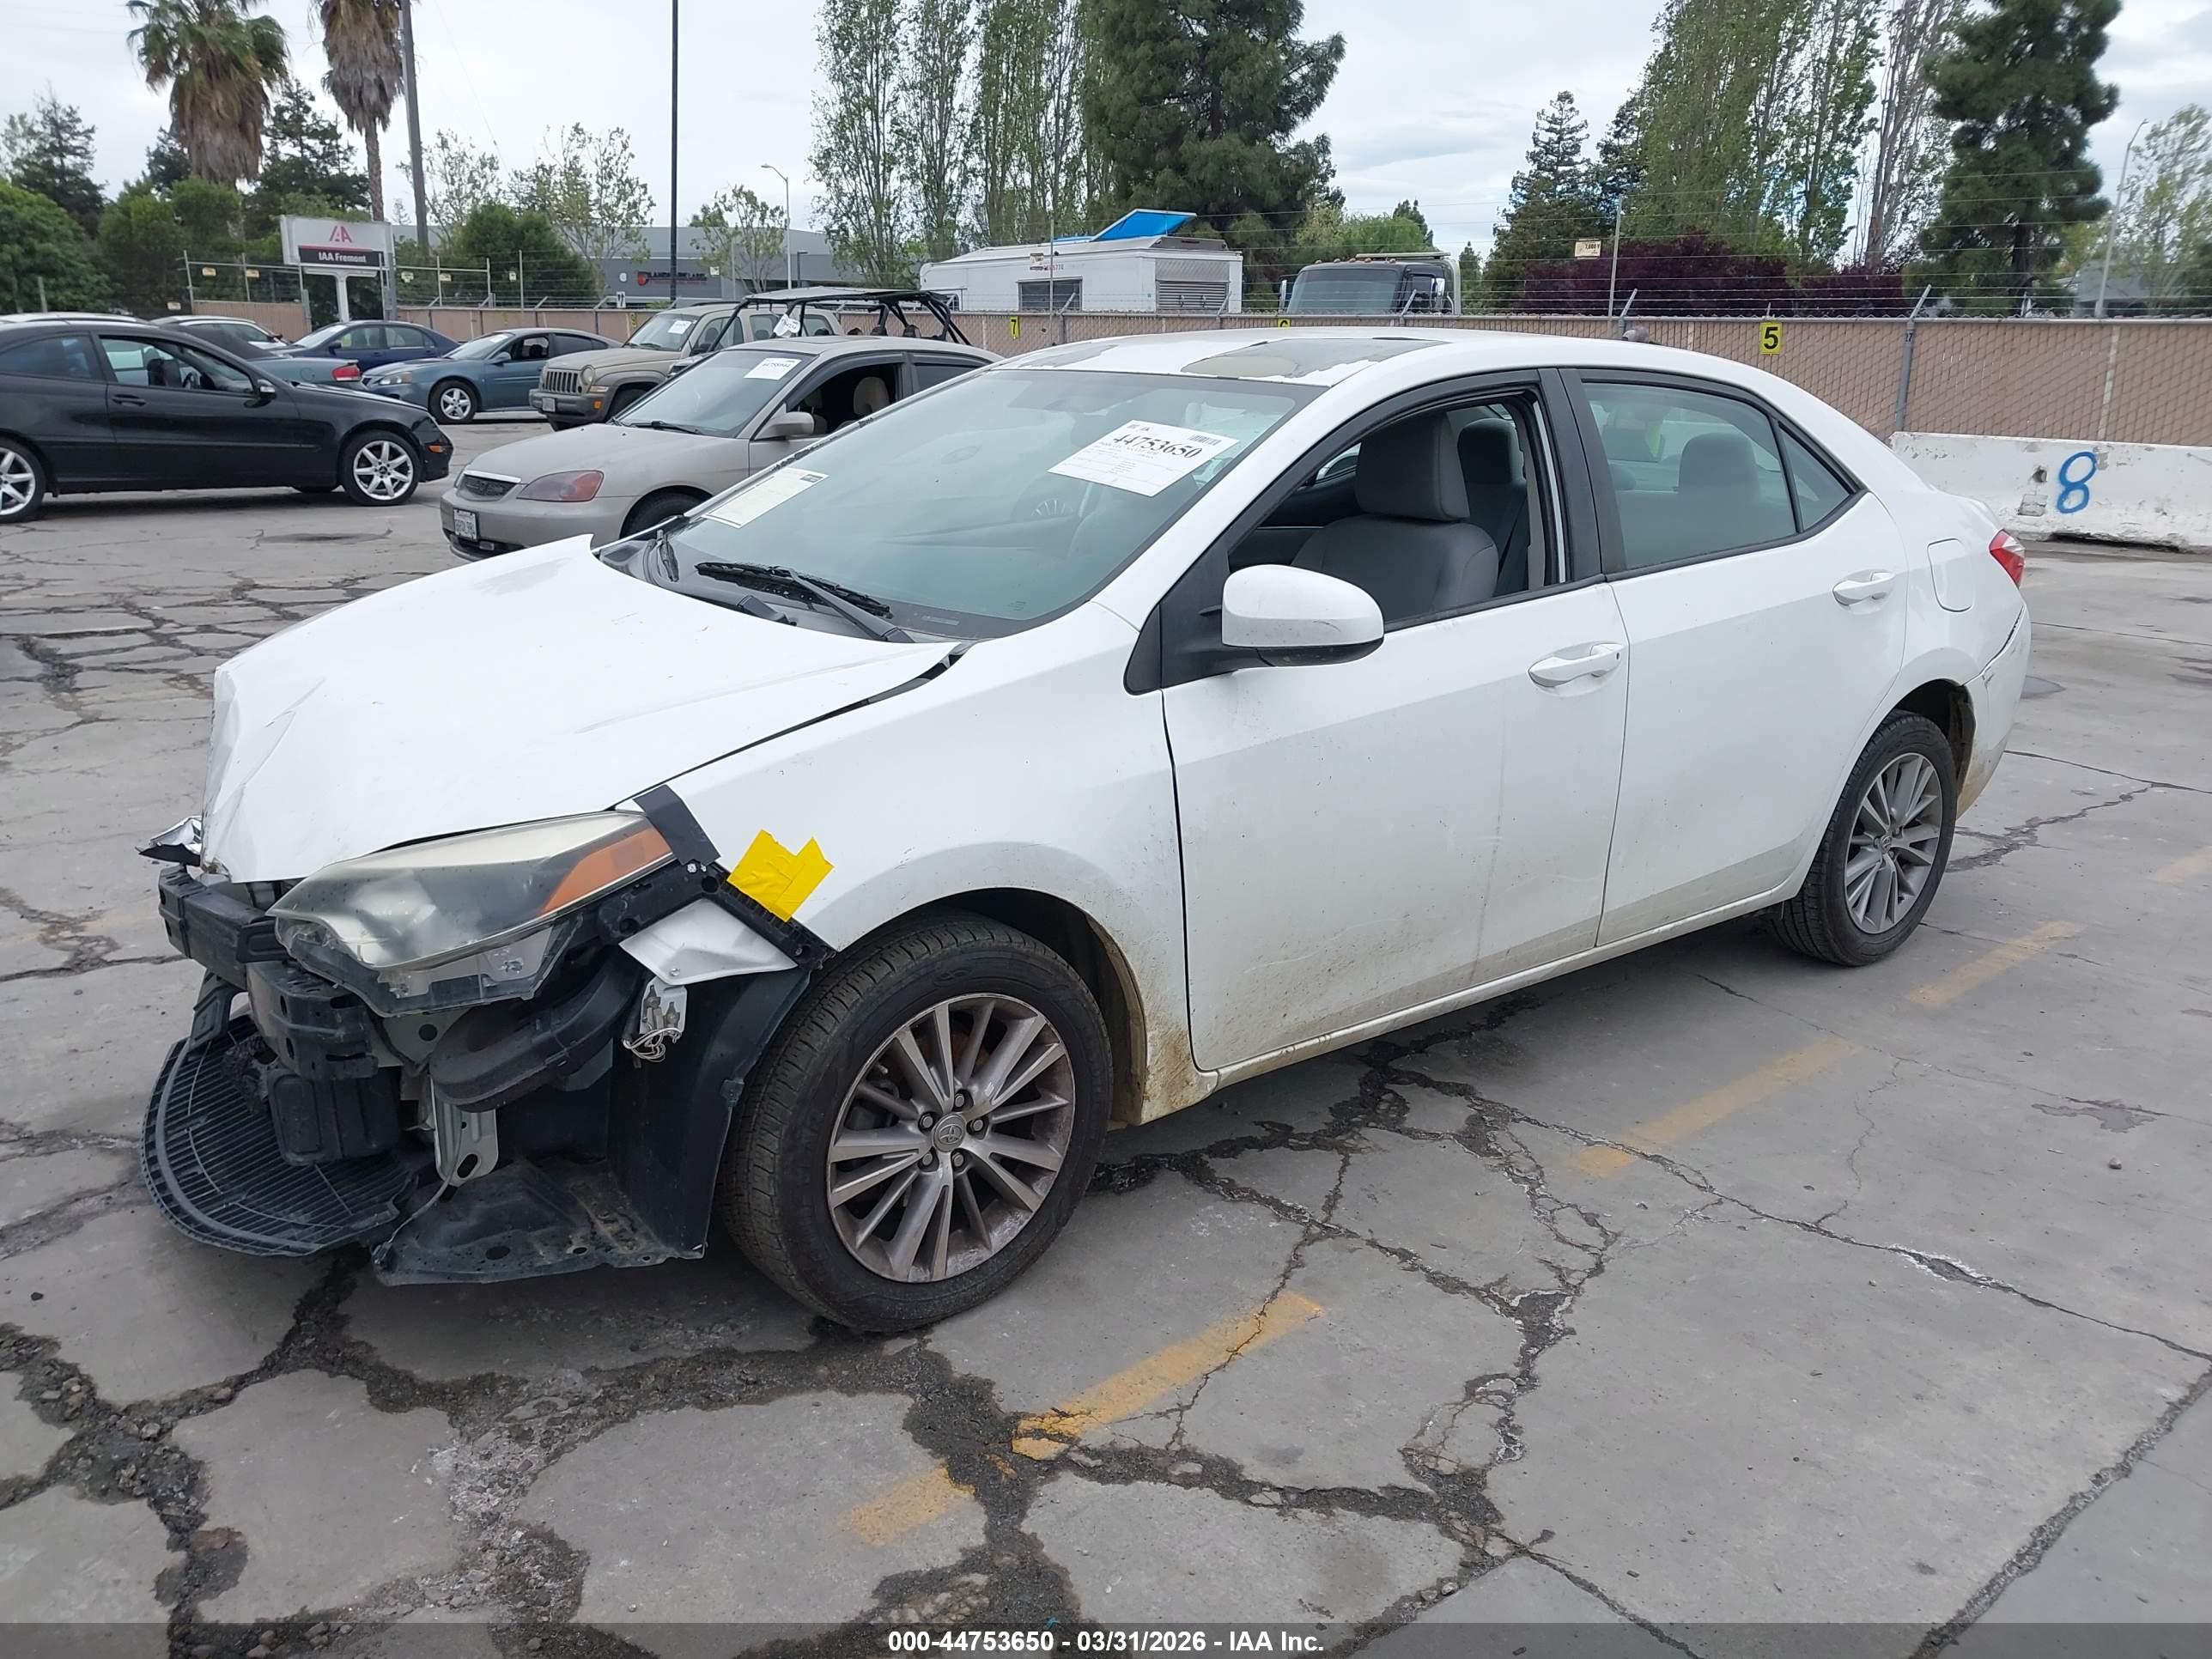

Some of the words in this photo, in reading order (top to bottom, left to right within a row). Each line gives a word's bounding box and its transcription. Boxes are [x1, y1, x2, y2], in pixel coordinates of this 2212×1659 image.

[319, 251, 334, 261] IAA
[335, 252, 367, 263] Fremont
[1011, 319, 1018, 335] 7
[1764, 326, 1779, 349] 5
[1113, 434, 1203, 459] 44753650
[2057, 451, 2097, 514] 8
